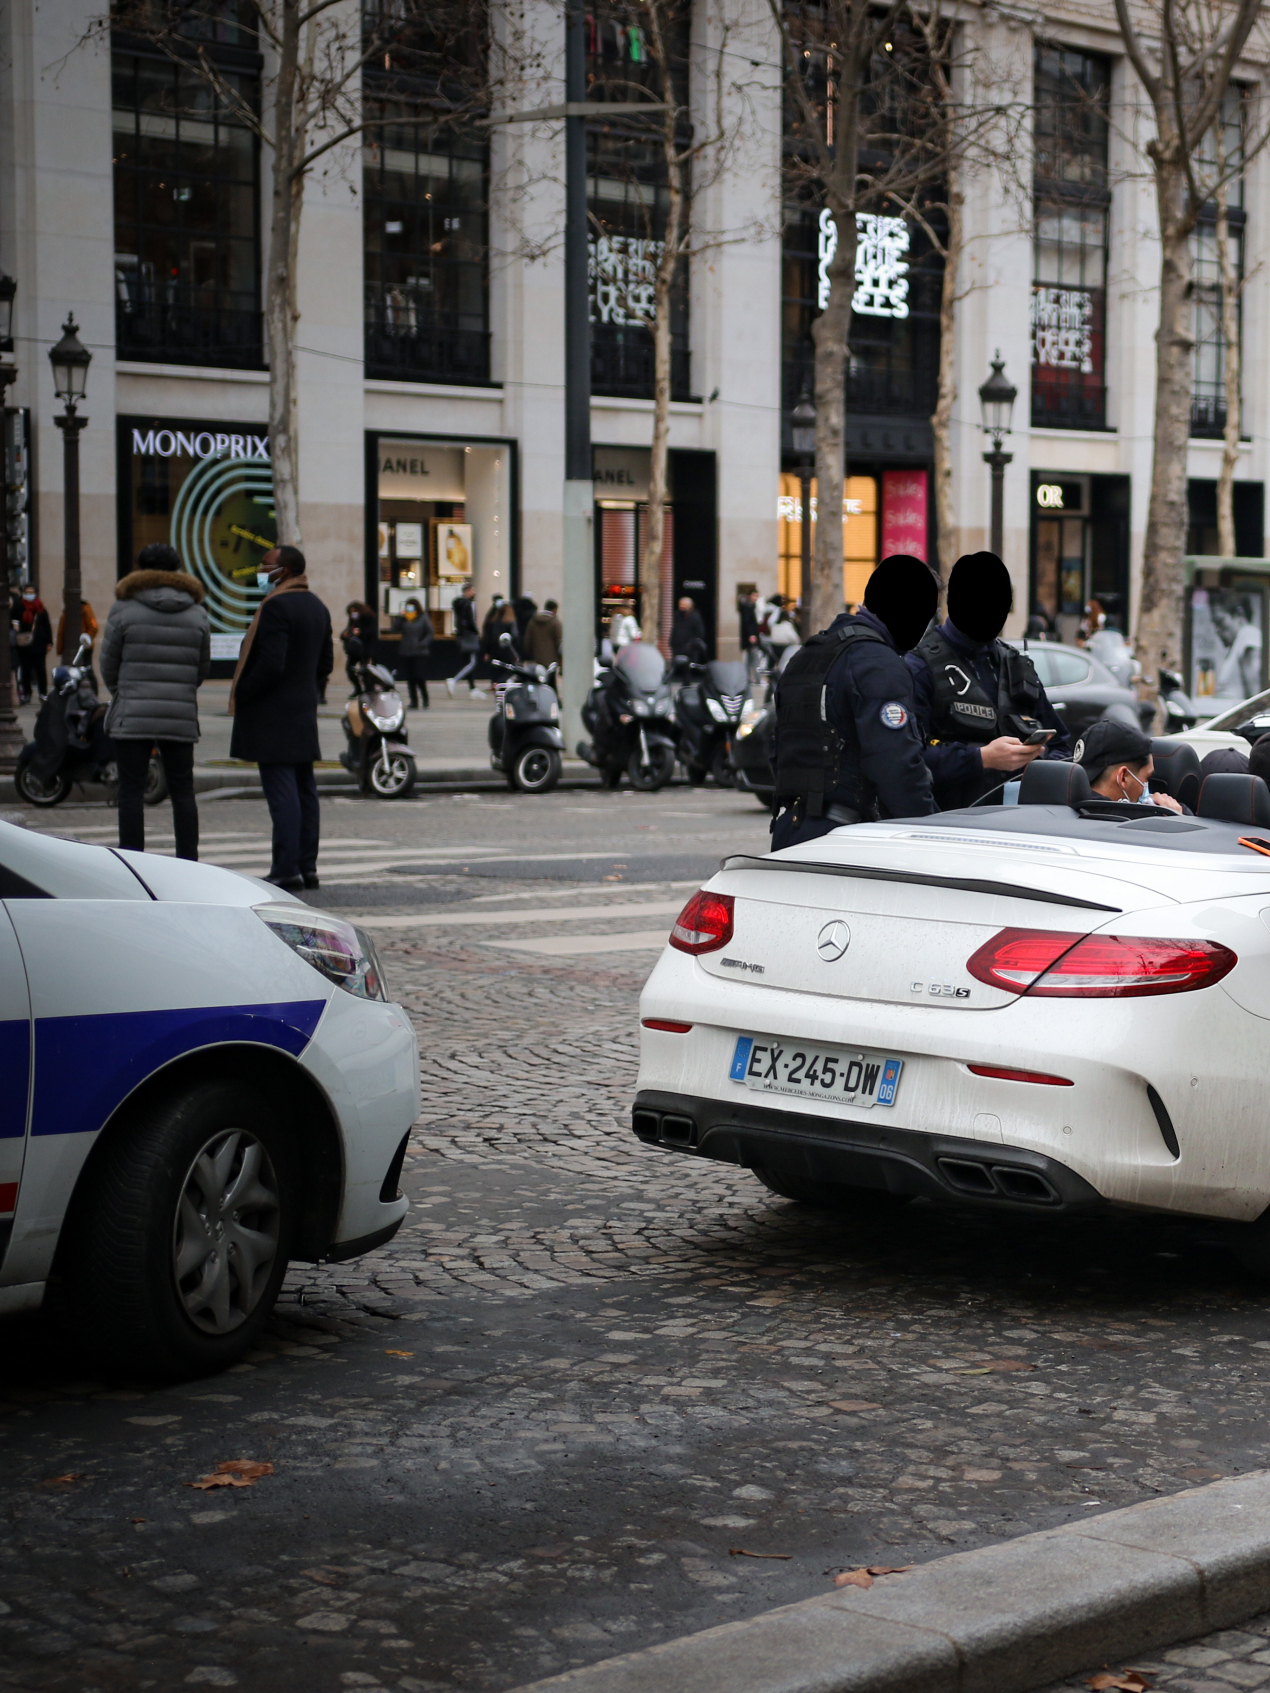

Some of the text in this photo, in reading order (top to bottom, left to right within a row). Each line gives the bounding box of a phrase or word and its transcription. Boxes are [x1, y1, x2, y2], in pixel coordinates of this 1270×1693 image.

[132, 428, 269, 459] MONOPRIX
[382, 457, 430, 475] ANEL
[593, 469, 634, 485] ANEL
[957, 703, 994, 718] POLICE
[910, 981, 923, 993] C
[735, 1062, 743, 1073] F
[879, 1083, 894, 1101] 06
